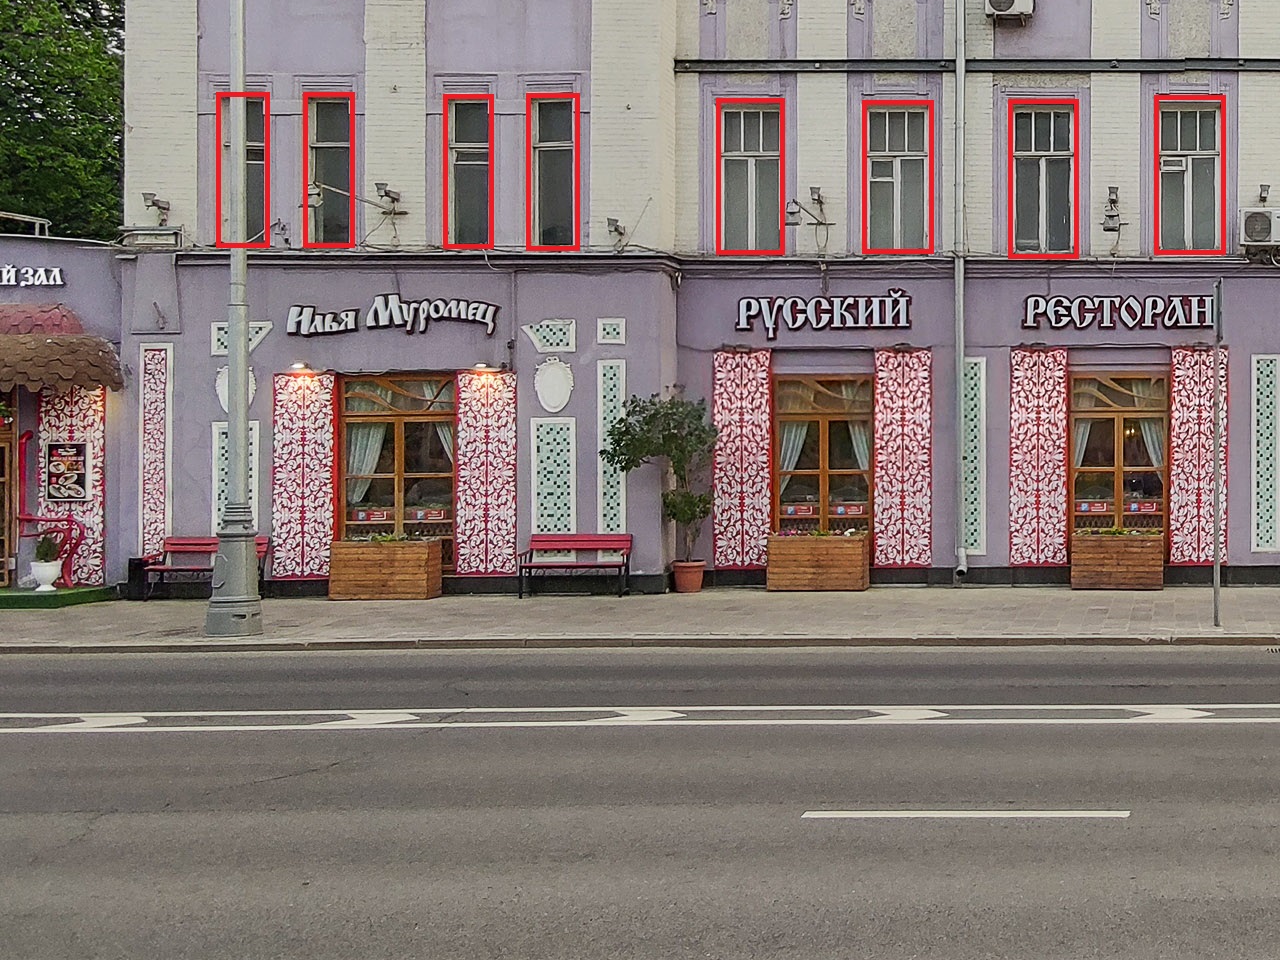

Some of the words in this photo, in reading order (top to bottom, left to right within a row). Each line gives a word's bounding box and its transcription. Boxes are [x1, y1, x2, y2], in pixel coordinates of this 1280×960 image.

[20, 266, 65, 287] ЗАЛ
[286, 305, 358, 336] Илья
[366, 293, 501, 335] Муромец
[736, 289, 911, 339] РУССКИЙ
[1023, 295, 1214, 329] РЕСТОРАН
